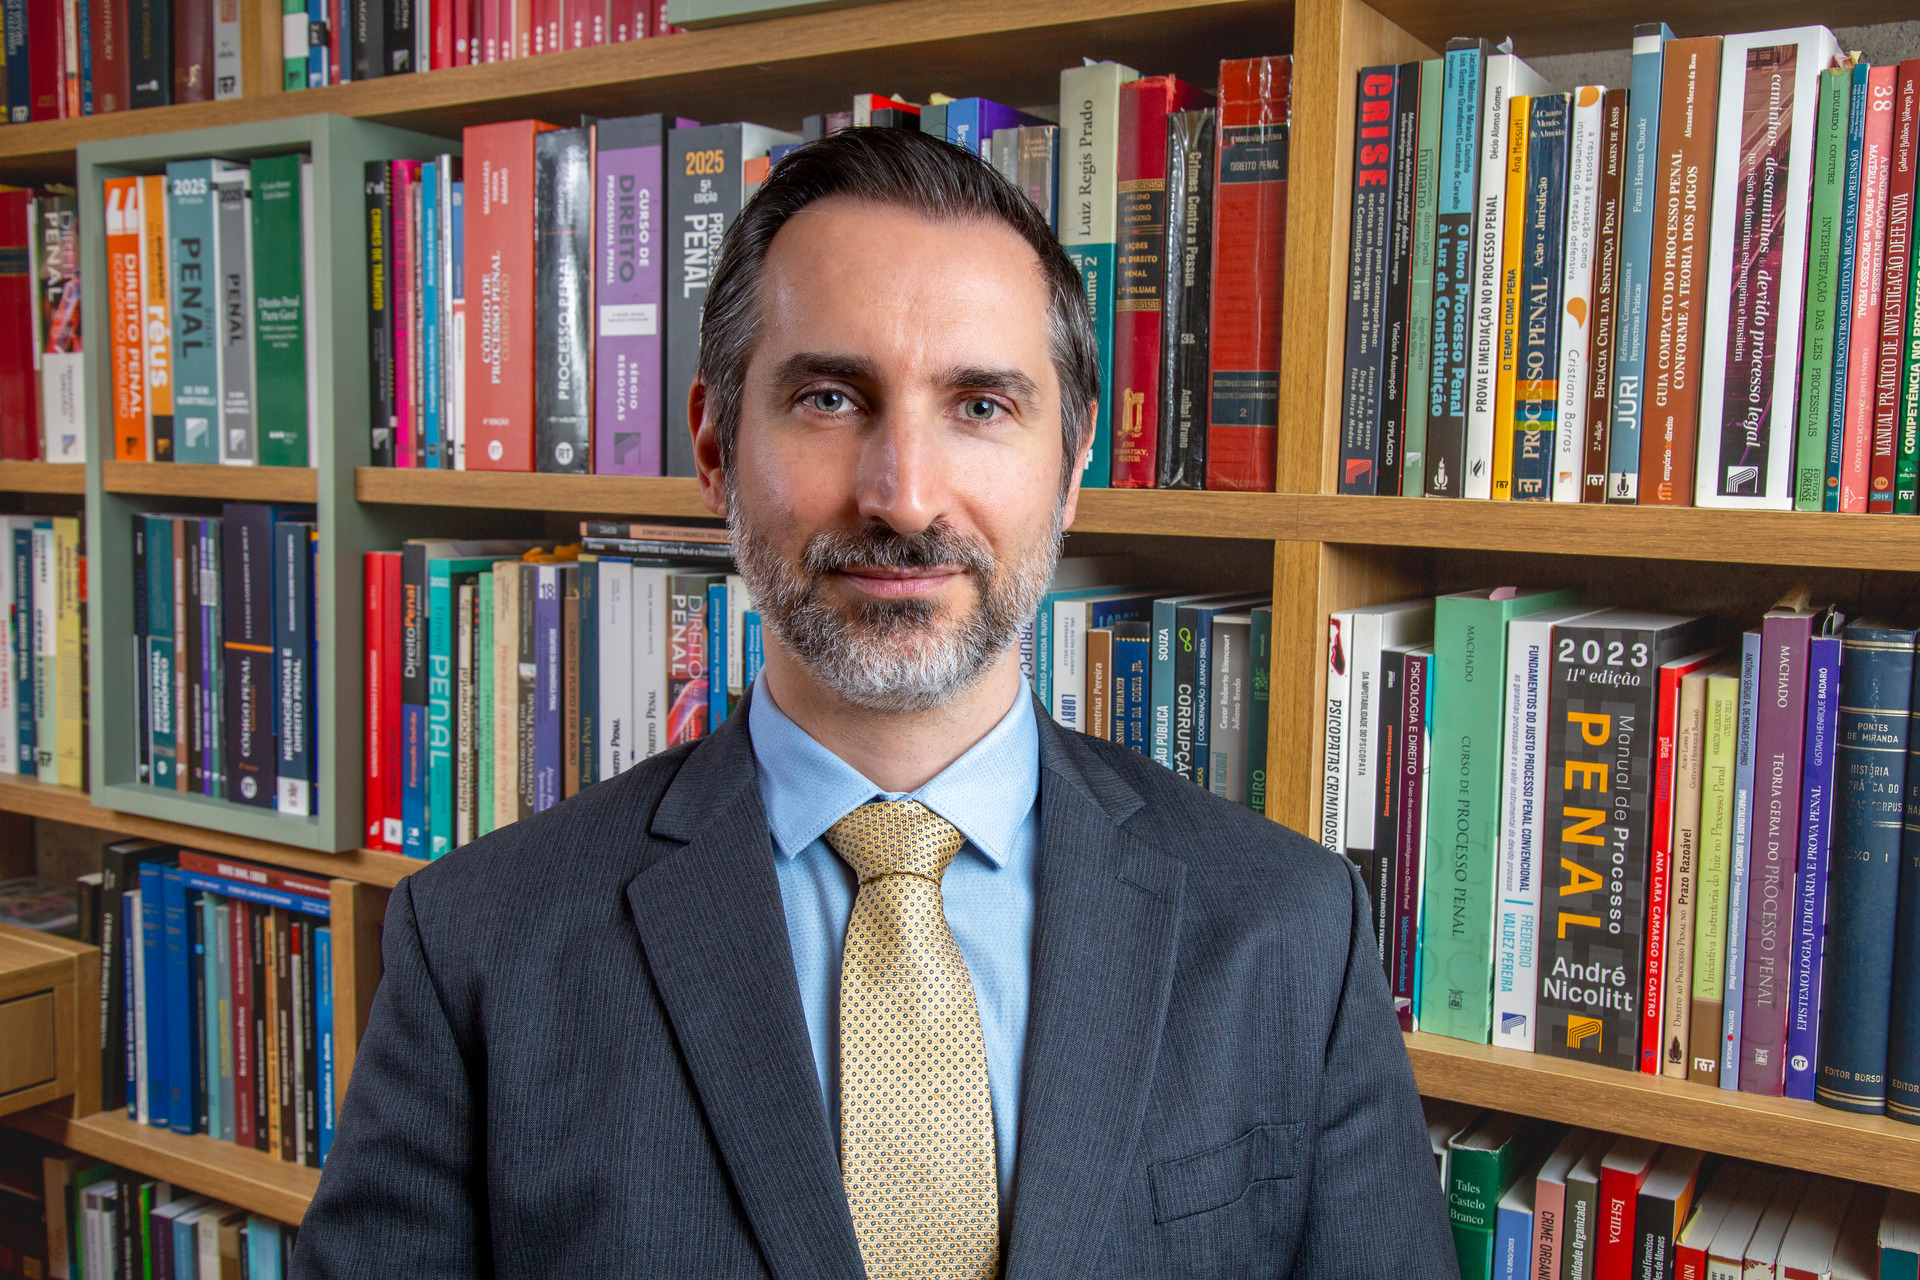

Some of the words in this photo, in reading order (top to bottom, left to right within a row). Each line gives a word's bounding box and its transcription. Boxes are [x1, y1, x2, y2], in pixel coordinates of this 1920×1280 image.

[1765, 75, 1783, 146] caminhos
[1873, 84, 1893, 111] 38
[1080, 100, 1093, 148] Prado
[1359, 74, 1392, 187] CRISE
[685, 150, 724, 175] 2025
[1080, 151, 1096, 195] Regis
[1188, 152, 1202, 192] Crimes
[1230, 161, 1257, 171] DIREITO
[1259, 160, 1280, 170] PENAL
[1669, 149, 1682, 194] PENAL
[173, 180, 208, 196] 2025
[1357, 193, 1365, 205] da
[1379, 192, 1385, 204] no
[1684, 166, 1697, 211] JOGOS
[1759, 157, 1778, 253] descaminhos
[606, 175, 615, 251] PROCESSUAL
[618, 175, 636, 283] DIREITO
[639, 189, 649, 244] CURSO
[1080, 198, 1091, 237] Luiz
[1187, 196, 1200, 235] Contra
[1367, 192, 1375, 228] escritos
[1438, 224, 1451, 234] à
[1457, 224, 1469, 233] O
[1484, 195, 1497, 229] PENAL
[1682, 214, 1694, 241] DOS
[1889, 192, 1908, 253] DEFENSIVA
[1125, 241, 1148, 250] LIÇÕES
[1354, 206, 1365, 263] Constituição
[1366, 230, 1372, 244] em
[1437, 239, 1450, 267] Luz
[1665, 197, 1679, 268] PROCESSO
[44, 212, 61, 302] PENAL
[492, 251, 502, 301] PENAL
[606, 255, 615, 285] PENAL
[639, 248, 649, 268] DE
[684, 214, 708, 298] PENAL
[1119, 256, 1126, 264] DE
[1129, 255, 1158, 263] DIREITO
[1125, 270, 1147, 278] PENAL
[1185, 246, 1200, 287] Pessoa
[1354, 265, 1361, 276] de
[1362, 247, 1373, 300] homenagem
[1375, 248, 1383, 273] penal
[1456, 240, 1469, 278] Novo
[1481, 232, 1495, 286] PROCESSO
[1679, 245, 1692, 296] TEORIA
[1816, 216, 1832, 302] INTERPRETAÇÃO
[124, 254, 138, 342] DIREITO
[181, 238, 203, 358] PENAL
[482, 274, 492, 297] DE
[1352, 280, 1364, 300] 1988
[1436, 272, 1449, 291] da
[1481, 289, 1492, 304] NO
[1663, 271, 1674, 291] DO
[1754, 270, 1771, 325] devido
[1883, 256, 1904, 336] INVESTIGAÇÃO
[1371, 275, 1381, 347] contemporâneo:
[1453, 284, 1467, 362] Processo
[1528, 277, 1548, 345] PENAL
[1679, 300, 1689, 309] A
[1814, 309, 1825, 330] DAS
[482, 299, 492, 364] CÓDIGO
[492, 302, 502, 385] PROCESSO
[1362, 320, 1370, 331] 30
[1478, 307, 1493, 366] IMEDIAÇÃO
[1658, 294, 1673, 369] COMPACTO
[149, 305, 170, 388] réus
[1431, 296, 1448, 417] Constituição
[1673, 312, 1688, 389] CONFORME
[1749, 330, 1767, 403] processo
[1812, 337, 1823, 360] LEIS
[1882, 339, 1898, 355] DE
[129, 347, 142, 418] PENAL
[616, 355, 626, 420] REBOUÇAS
[630, 362, 638, 410] SÉRGIO
[1451, 368, 1464, 417] Penal
[1475, 377, 1488, 412] PROVA
[1565, 349, 1580, 406] Cristiano
[1656, 373, 1668, 406] GUIA
[1879, 358, 1897, 406] PRÁTICO
[1180, 389, 1192, 418] Aníbal
[1519, 351, 1548, 458] PROCESSO
[1615, 375, 1638, 429] JÚRI
[1807, 367, 1824, 437] PROCESSUAIS
[1180, 421, 1190, 449] Bruno
[1562, 412, 1576, 452] Barros
[1747, 407, 1762, 447] legal
[1875, 409, 1894, 455] MANUAL
[283, 646, 292, 656] E
[672, 594, 687, 676] PENAL
[688, 596, 703, 679] DIREITO
[1158, 628, 1169, 661] SOUZA
[1222, 634, 1230, 673] Bitencourt
[1464, 625, 1475, 682] MACHADO
[1559, 638, 1648, 667] 2023
[241, 656, 250, 698] PENAL
[293, 658, 303, 702] PENAL
[1221, 675, 1229, 704] Roberto
[1233, 678, 1241, 701] Breda
[1526, 645, 1539, 709] FUNDAMENTOS
[1589, 670, 1640, 688] edição
[283, 658, 294, 760] NEUROCIÊNCIAS
[292, 706, 303, 752] DIREITO
[1062, 694, 1076, 723] LOBBY
[1155, 705, 1169, 746] PÚBLICA
[1220, 706, 1228, 729] Cezar
[1232, 703, 1241, 730] Juliano
[1526, 711, 1536, 723] DO
[240, 701, 251, 758] CÓDIGO
[1327, 699, 1341, 773] PSICOPATAS
[1525, 725, 1535, 751] JUSTO
[1460, 735, 1471, 776] CURSO
[1616, 715, 1635, 790] Manual
[1459, 779, 1469, 794] DE
[1523, 753, 1534, 797] PROCESSO
[1324, 775, 1339, 852] CRIMINOSOS
[1522, 799, 1533, 825] PENAL
[1557, 711, 1611, 939] PENAL
[1614, 796, 1630, 820] de
[1454, 799, 1470, 882] PROCESSO
[1519, 828, 1532, 892] CONVENCIONAL
[1608, 827, 1629, 934] Processo
[1655, 850, 1664, 873] ANA
[1654, 876, 1662, 902] LARA
[1452, 887, 1466, 936] PENAL
[1502, 911, 1515, 949] VALDEZ
[1650, 906, 1661, 957] CAMARGO
[1518, 915, 1533, 968] FREDERICO
[1500, 951, 1514, 992] PEREIRA
[1552, 957, 1626, 986] André
[1649, 961, 1658, 974] DE
[1543, 978, 1633, 1012] Nicolitt
[1647, 977, 1657, 1017] CASTRO
[1450, 1193, 1485, 1210] Castelo
[1456, 1179, 1480, 1194] Tales
[1450, 1208, 1484, 1225] Branco
[1540, 1211, 1554, 1243] CRIME
[1572, 1200, 1586, 1249] Organizada
[1609, 1198, 1625, 1244] ISHIDA
